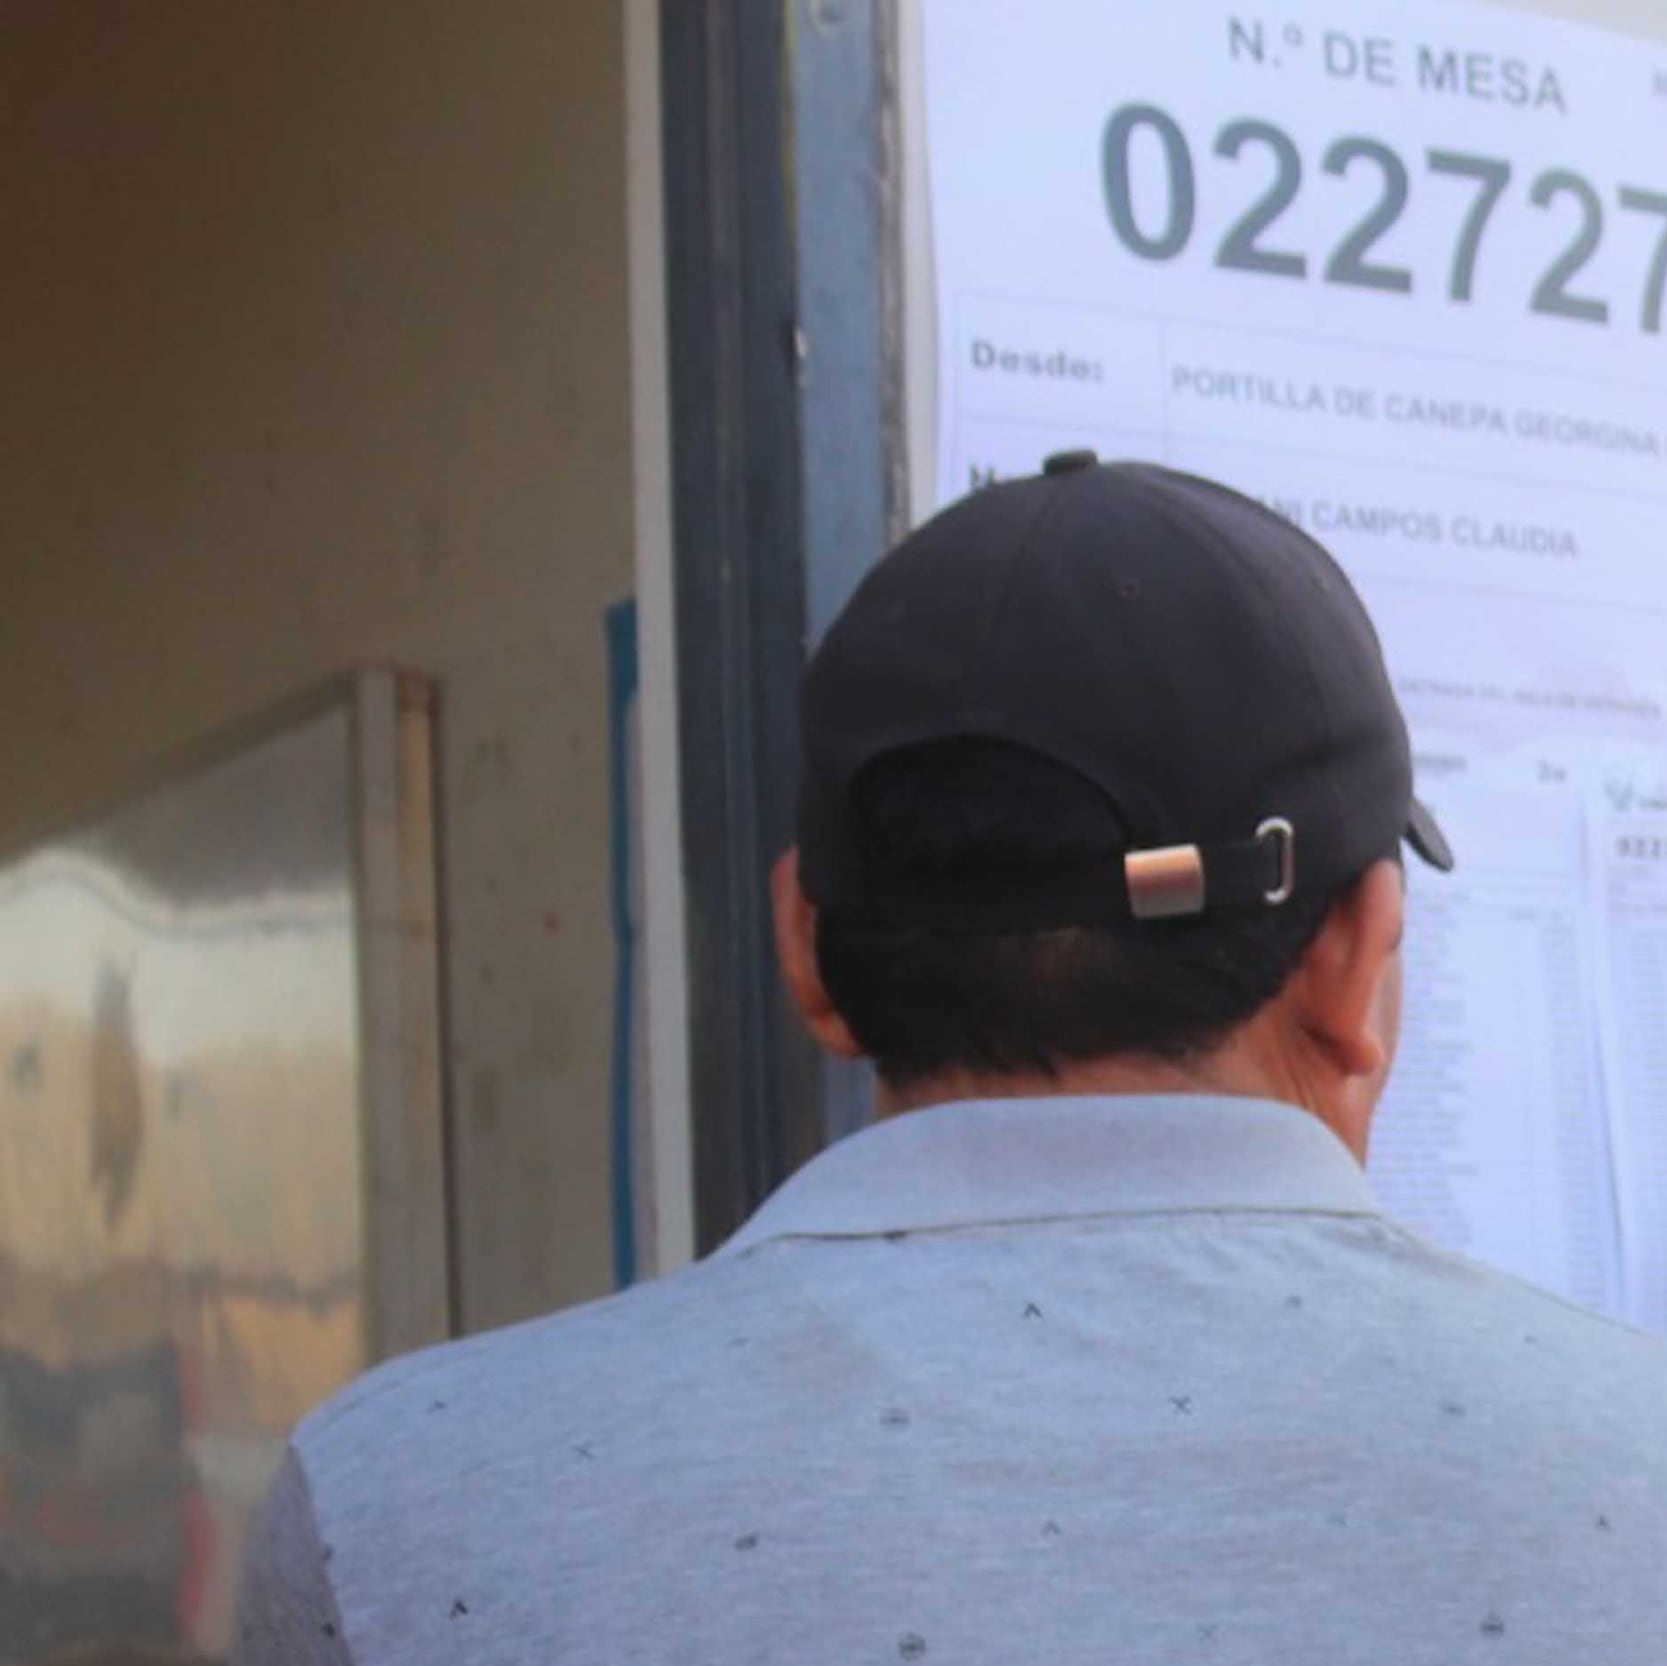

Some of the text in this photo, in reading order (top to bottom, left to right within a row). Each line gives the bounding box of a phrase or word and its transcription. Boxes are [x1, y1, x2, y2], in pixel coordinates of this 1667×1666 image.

[1324, 30, 1396, 86] DE
[1416, 44, 1569, 115] MESA
[970, 339, 1104, 384] Desde:
[1171, 363, 1326, 411] PORTILLA
[1333, 385, 1378, 421] DE
[1384, 392, 1507, 435] CANEPA
[1513, 411, 1659, 457] GEORGINA
[1310, 498, 1442, 543] CAMPOS
[1450, 515, 1578, 559] CLAUDIA
